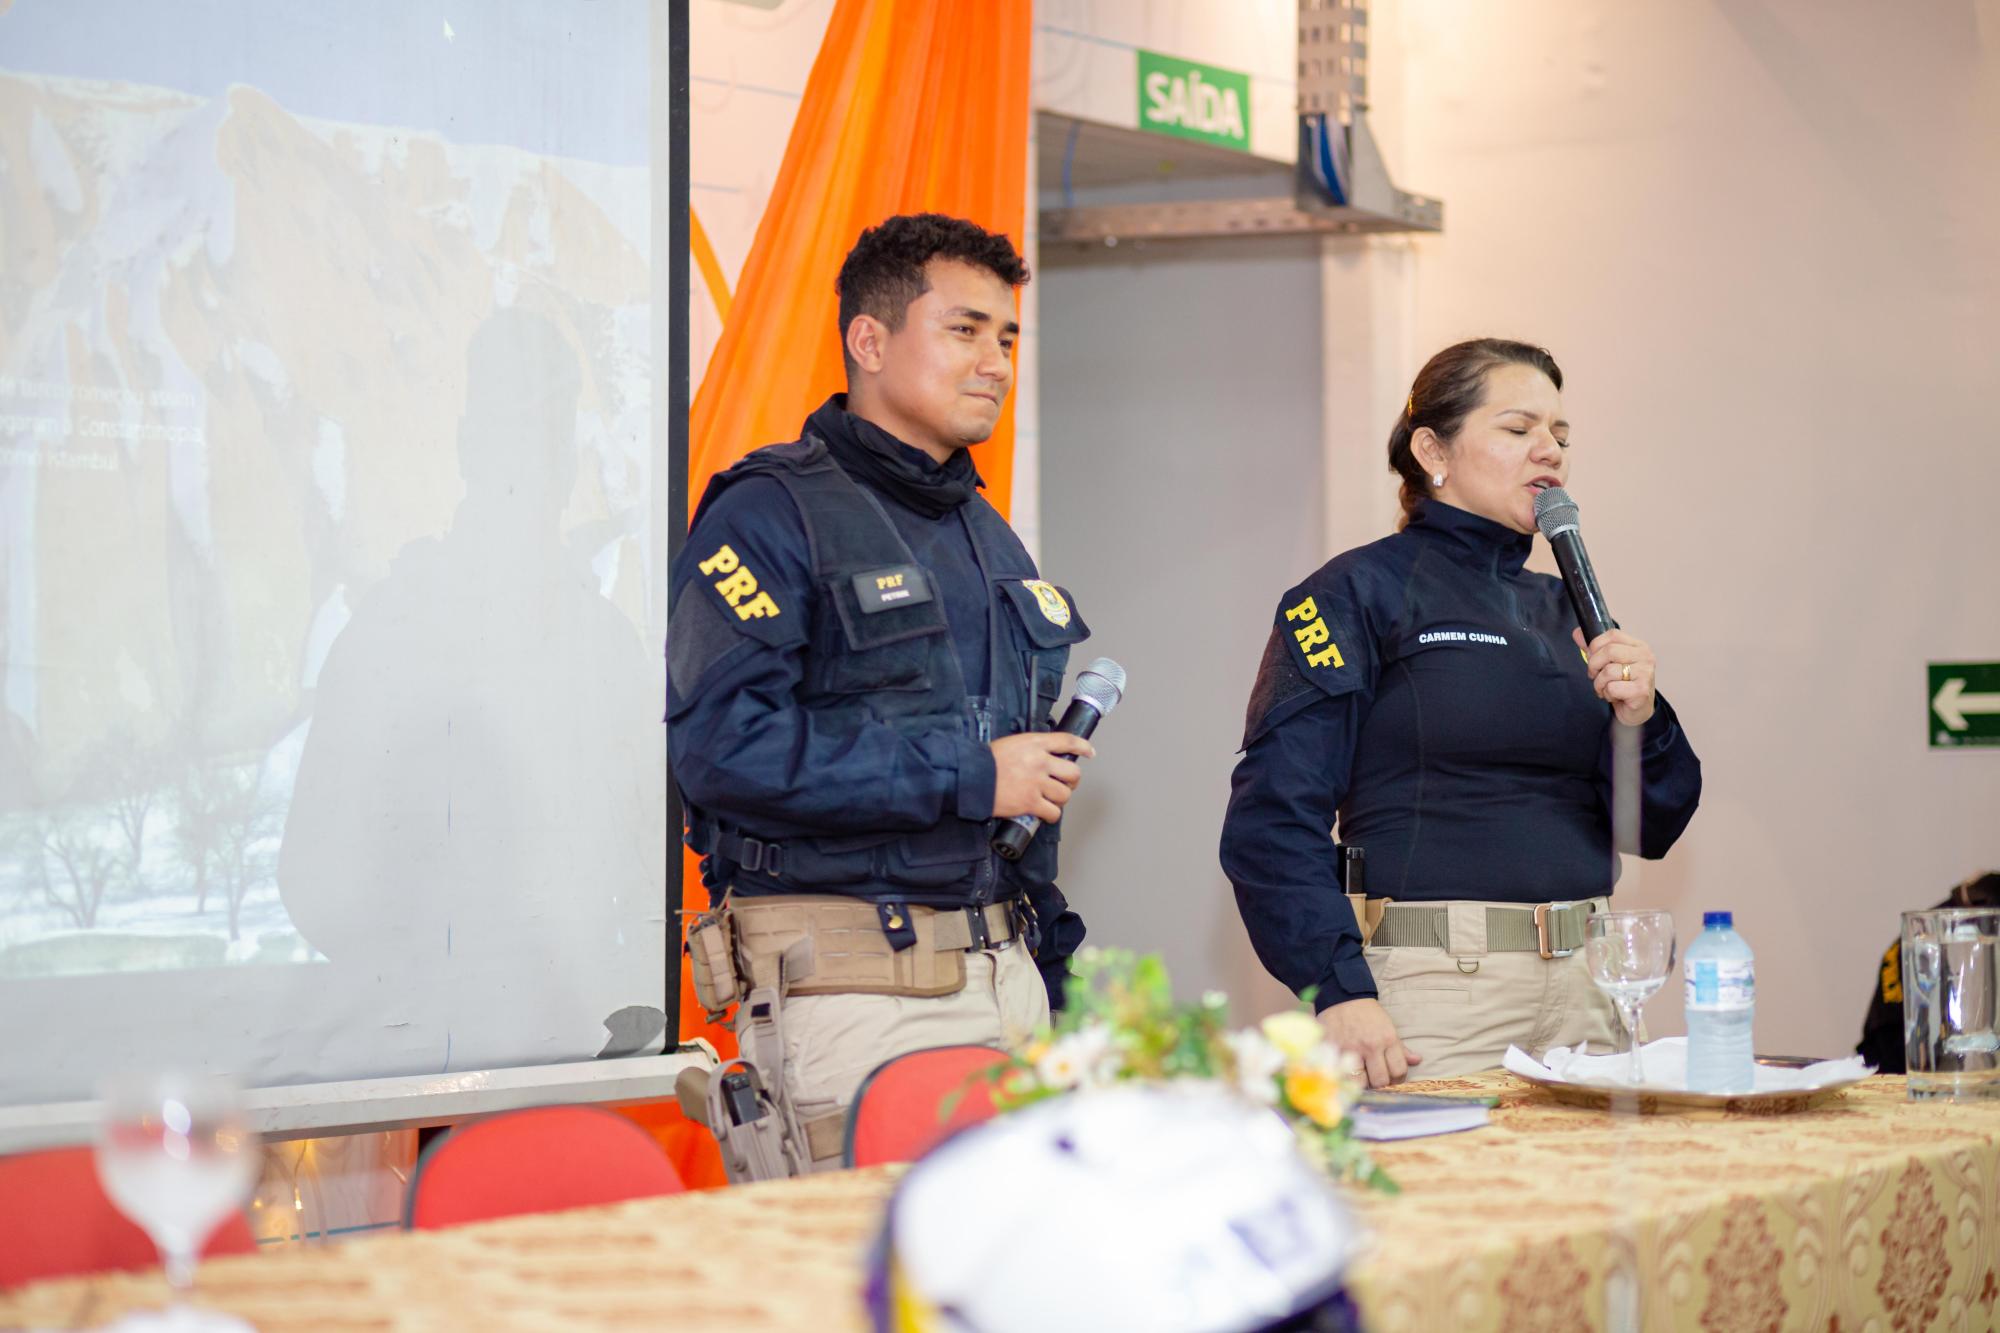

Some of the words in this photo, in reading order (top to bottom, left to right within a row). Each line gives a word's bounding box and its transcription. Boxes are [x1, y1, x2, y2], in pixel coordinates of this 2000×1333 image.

[1146, 69, 1244, 140] SAÍDA
[698, 544, 780, 621] PRF
[876, 574, 903, 590] PRF
[1285, 596, 1345, 668] PRF
[1419, 632, 1466, 643] CARMEM
[1469, 633, 1508, 645] CUNHA
